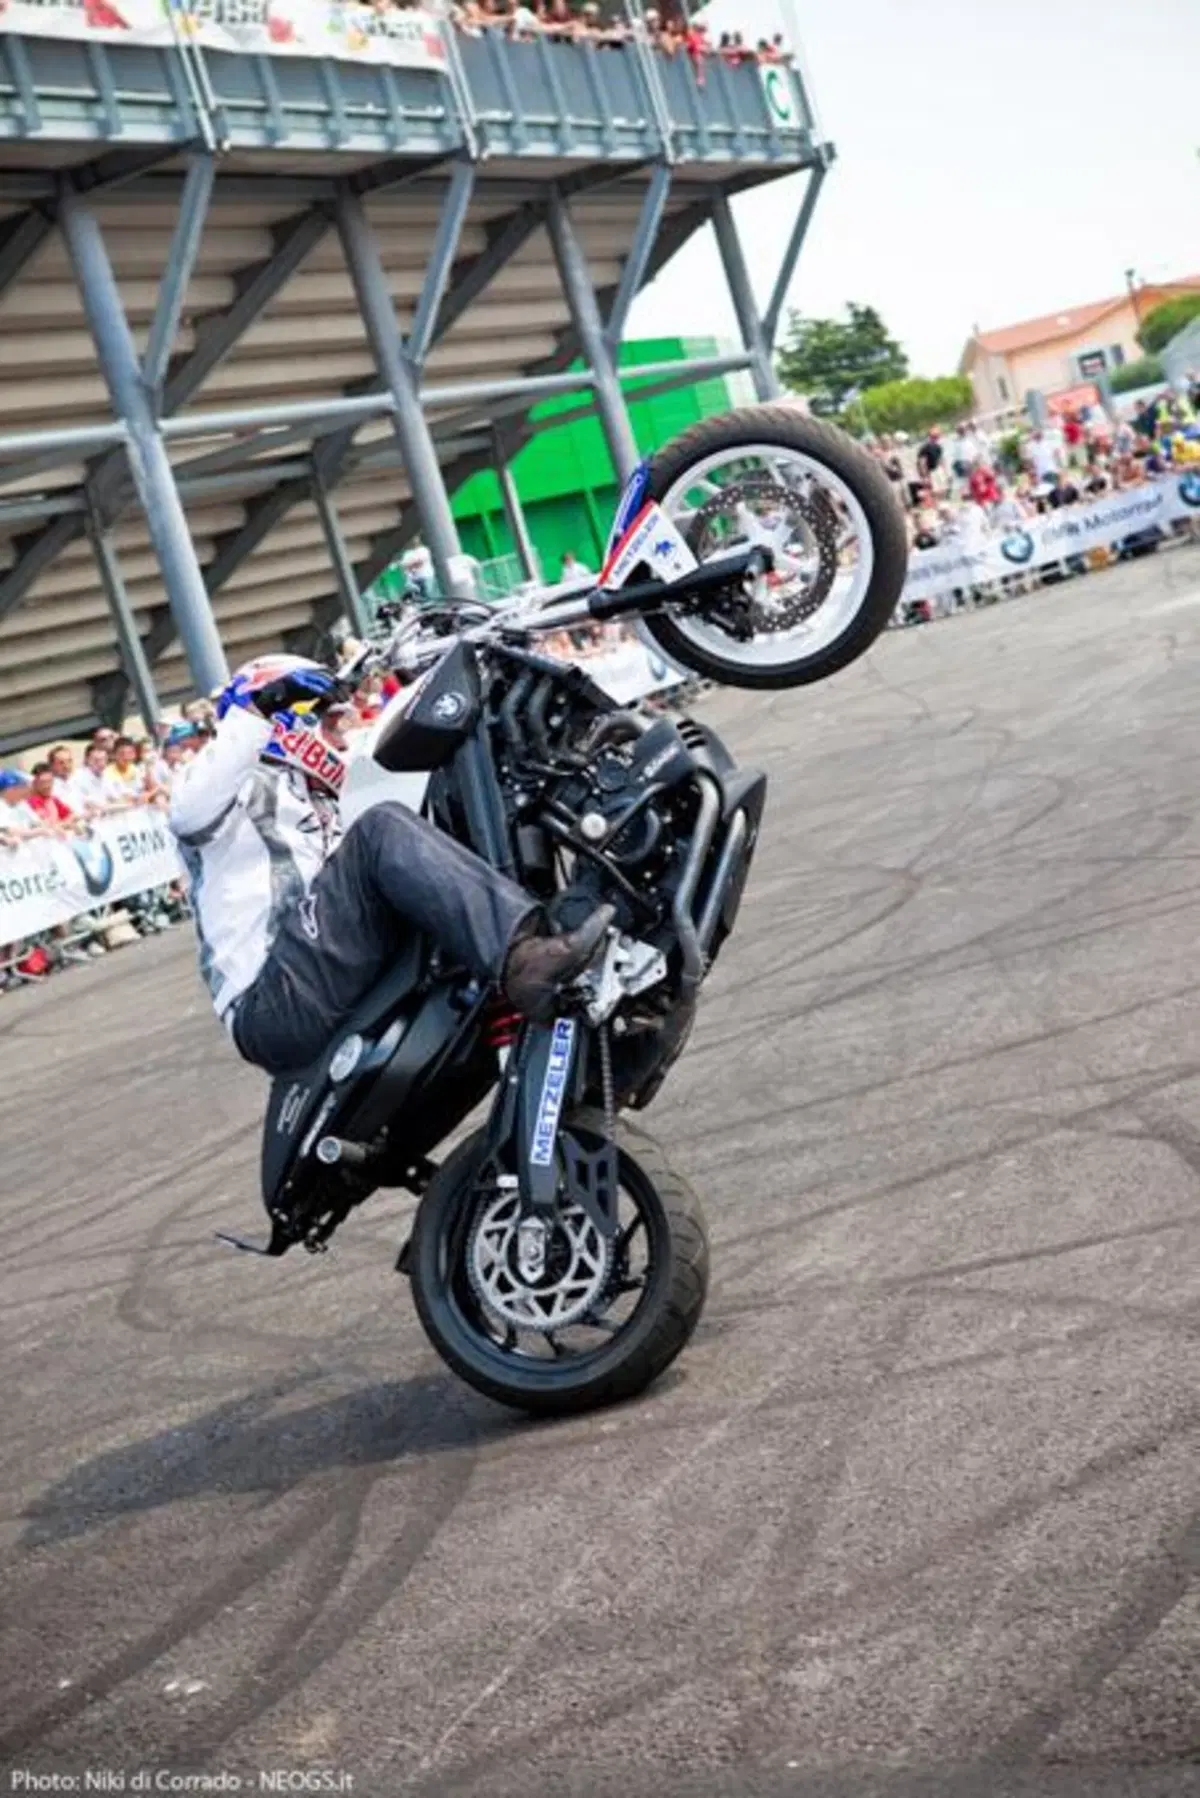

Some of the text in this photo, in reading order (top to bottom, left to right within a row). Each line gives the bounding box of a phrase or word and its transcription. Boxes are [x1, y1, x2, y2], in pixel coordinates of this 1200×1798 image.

[766, 70, 792, 121] C
[117, 828, 166, 864] BMW
[534, 1020, 574, 1162] METZELER
